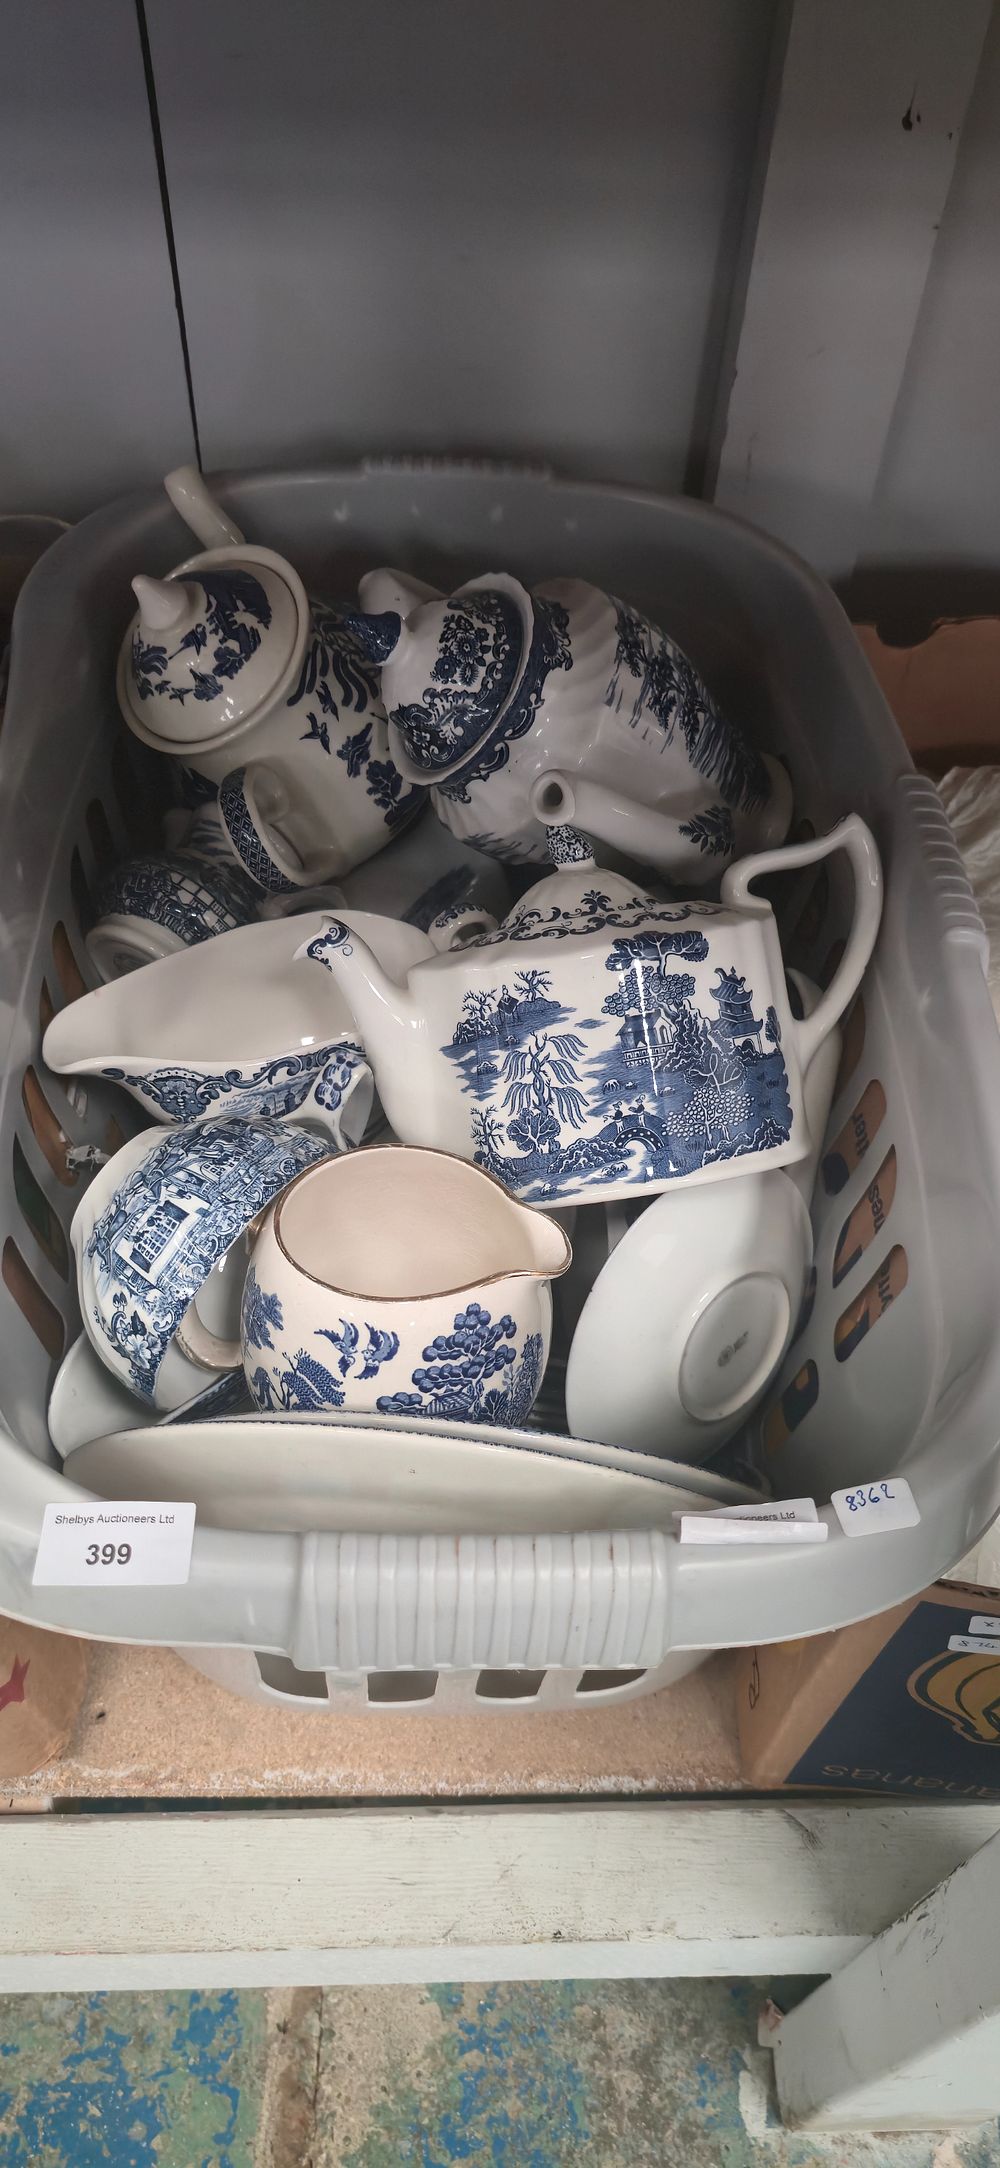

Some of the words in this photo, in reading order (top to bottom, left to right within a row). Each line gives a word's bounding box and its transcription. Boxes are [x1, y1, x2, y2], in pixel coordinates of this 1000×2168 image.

[845, 1483, 896, 1512] 8362
[54, 1514, 95, 1526] Shelbys
[96, 1513, 157, 1524] Auctioneers
[159, 1514, 175, 1524] Ltd
[780, 1510, 796, 1520] Ltd
[85, 1543, 133, 1566] 399
